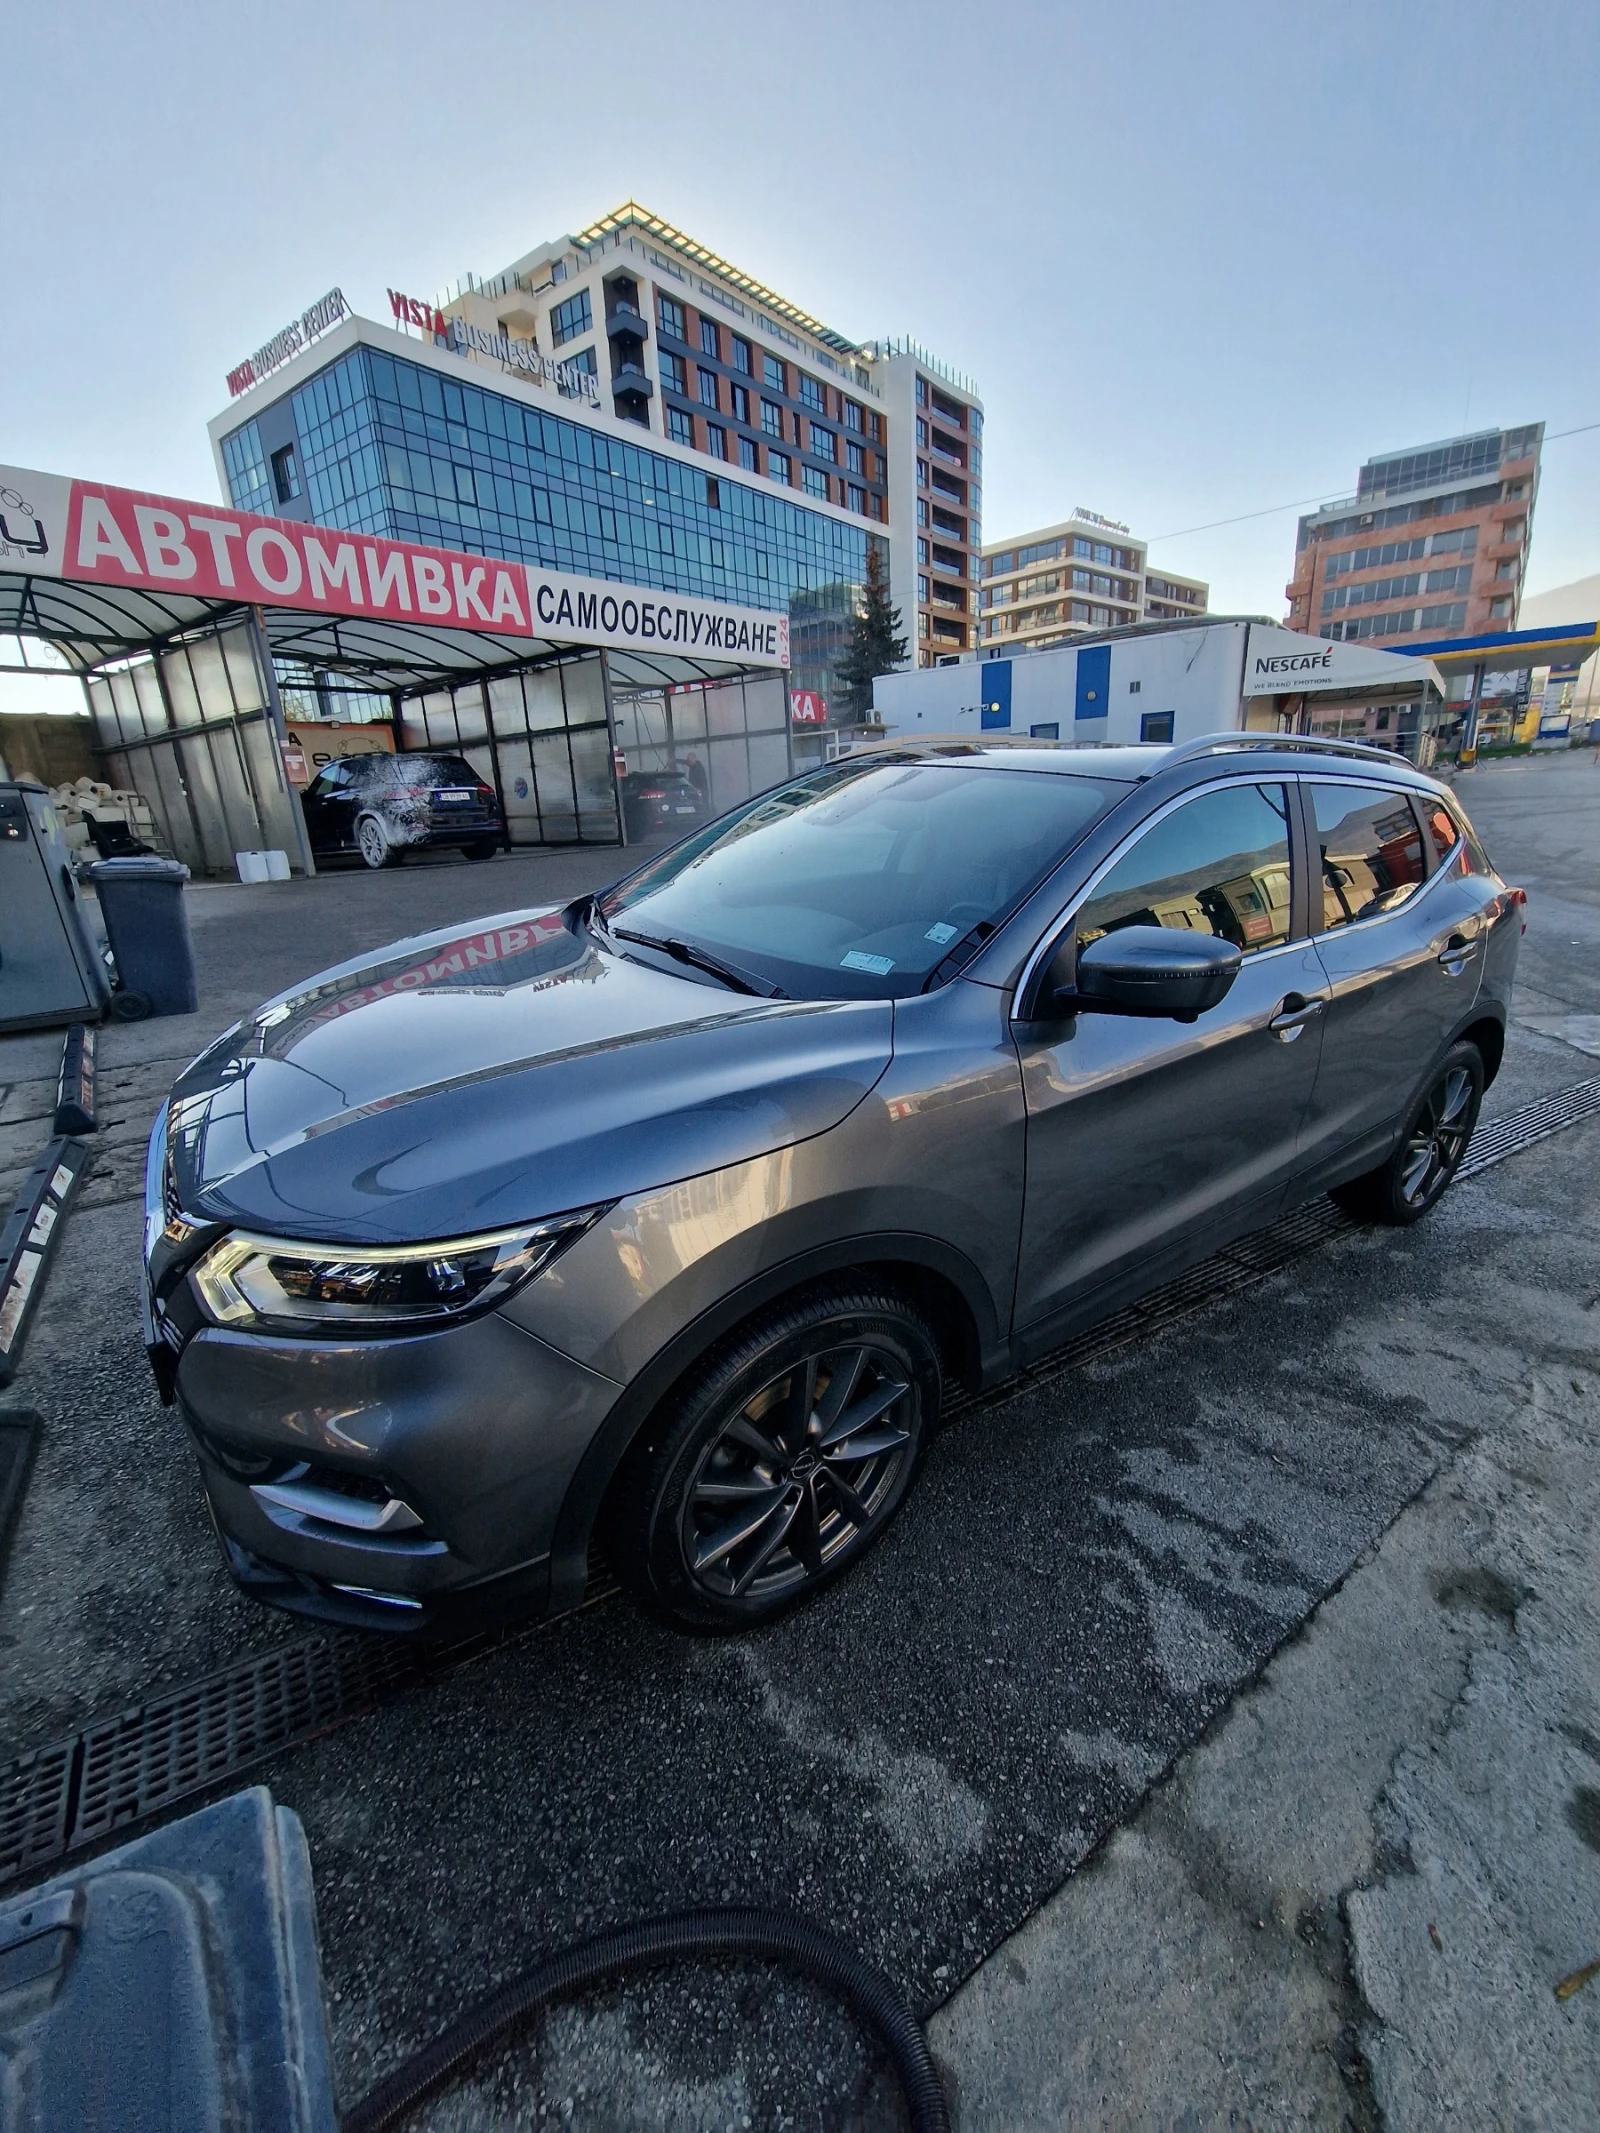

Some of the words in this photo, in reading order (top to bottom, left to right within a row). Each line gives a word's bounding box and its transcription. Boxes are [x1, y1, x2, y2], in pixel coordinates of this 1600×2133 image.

[226, 358, 256, 397] VISTA
[251, 320, 303, 379] BUSINESS
[301, 287, 345, 340] CENTER
[387, 287, 448, 339] VISTA
[452, 316, 540, 374] BUSINESS
[541, 354, 598, 400] CENTER
[77, 495, 527, 627] АВТОМИВКА
[536, 584, 778, 655] САМООБСЛУЖВАНЕ
[1267, 681, 1292, 689] BLEND
[1293, 677, 1333, 687] EMOTIONS
